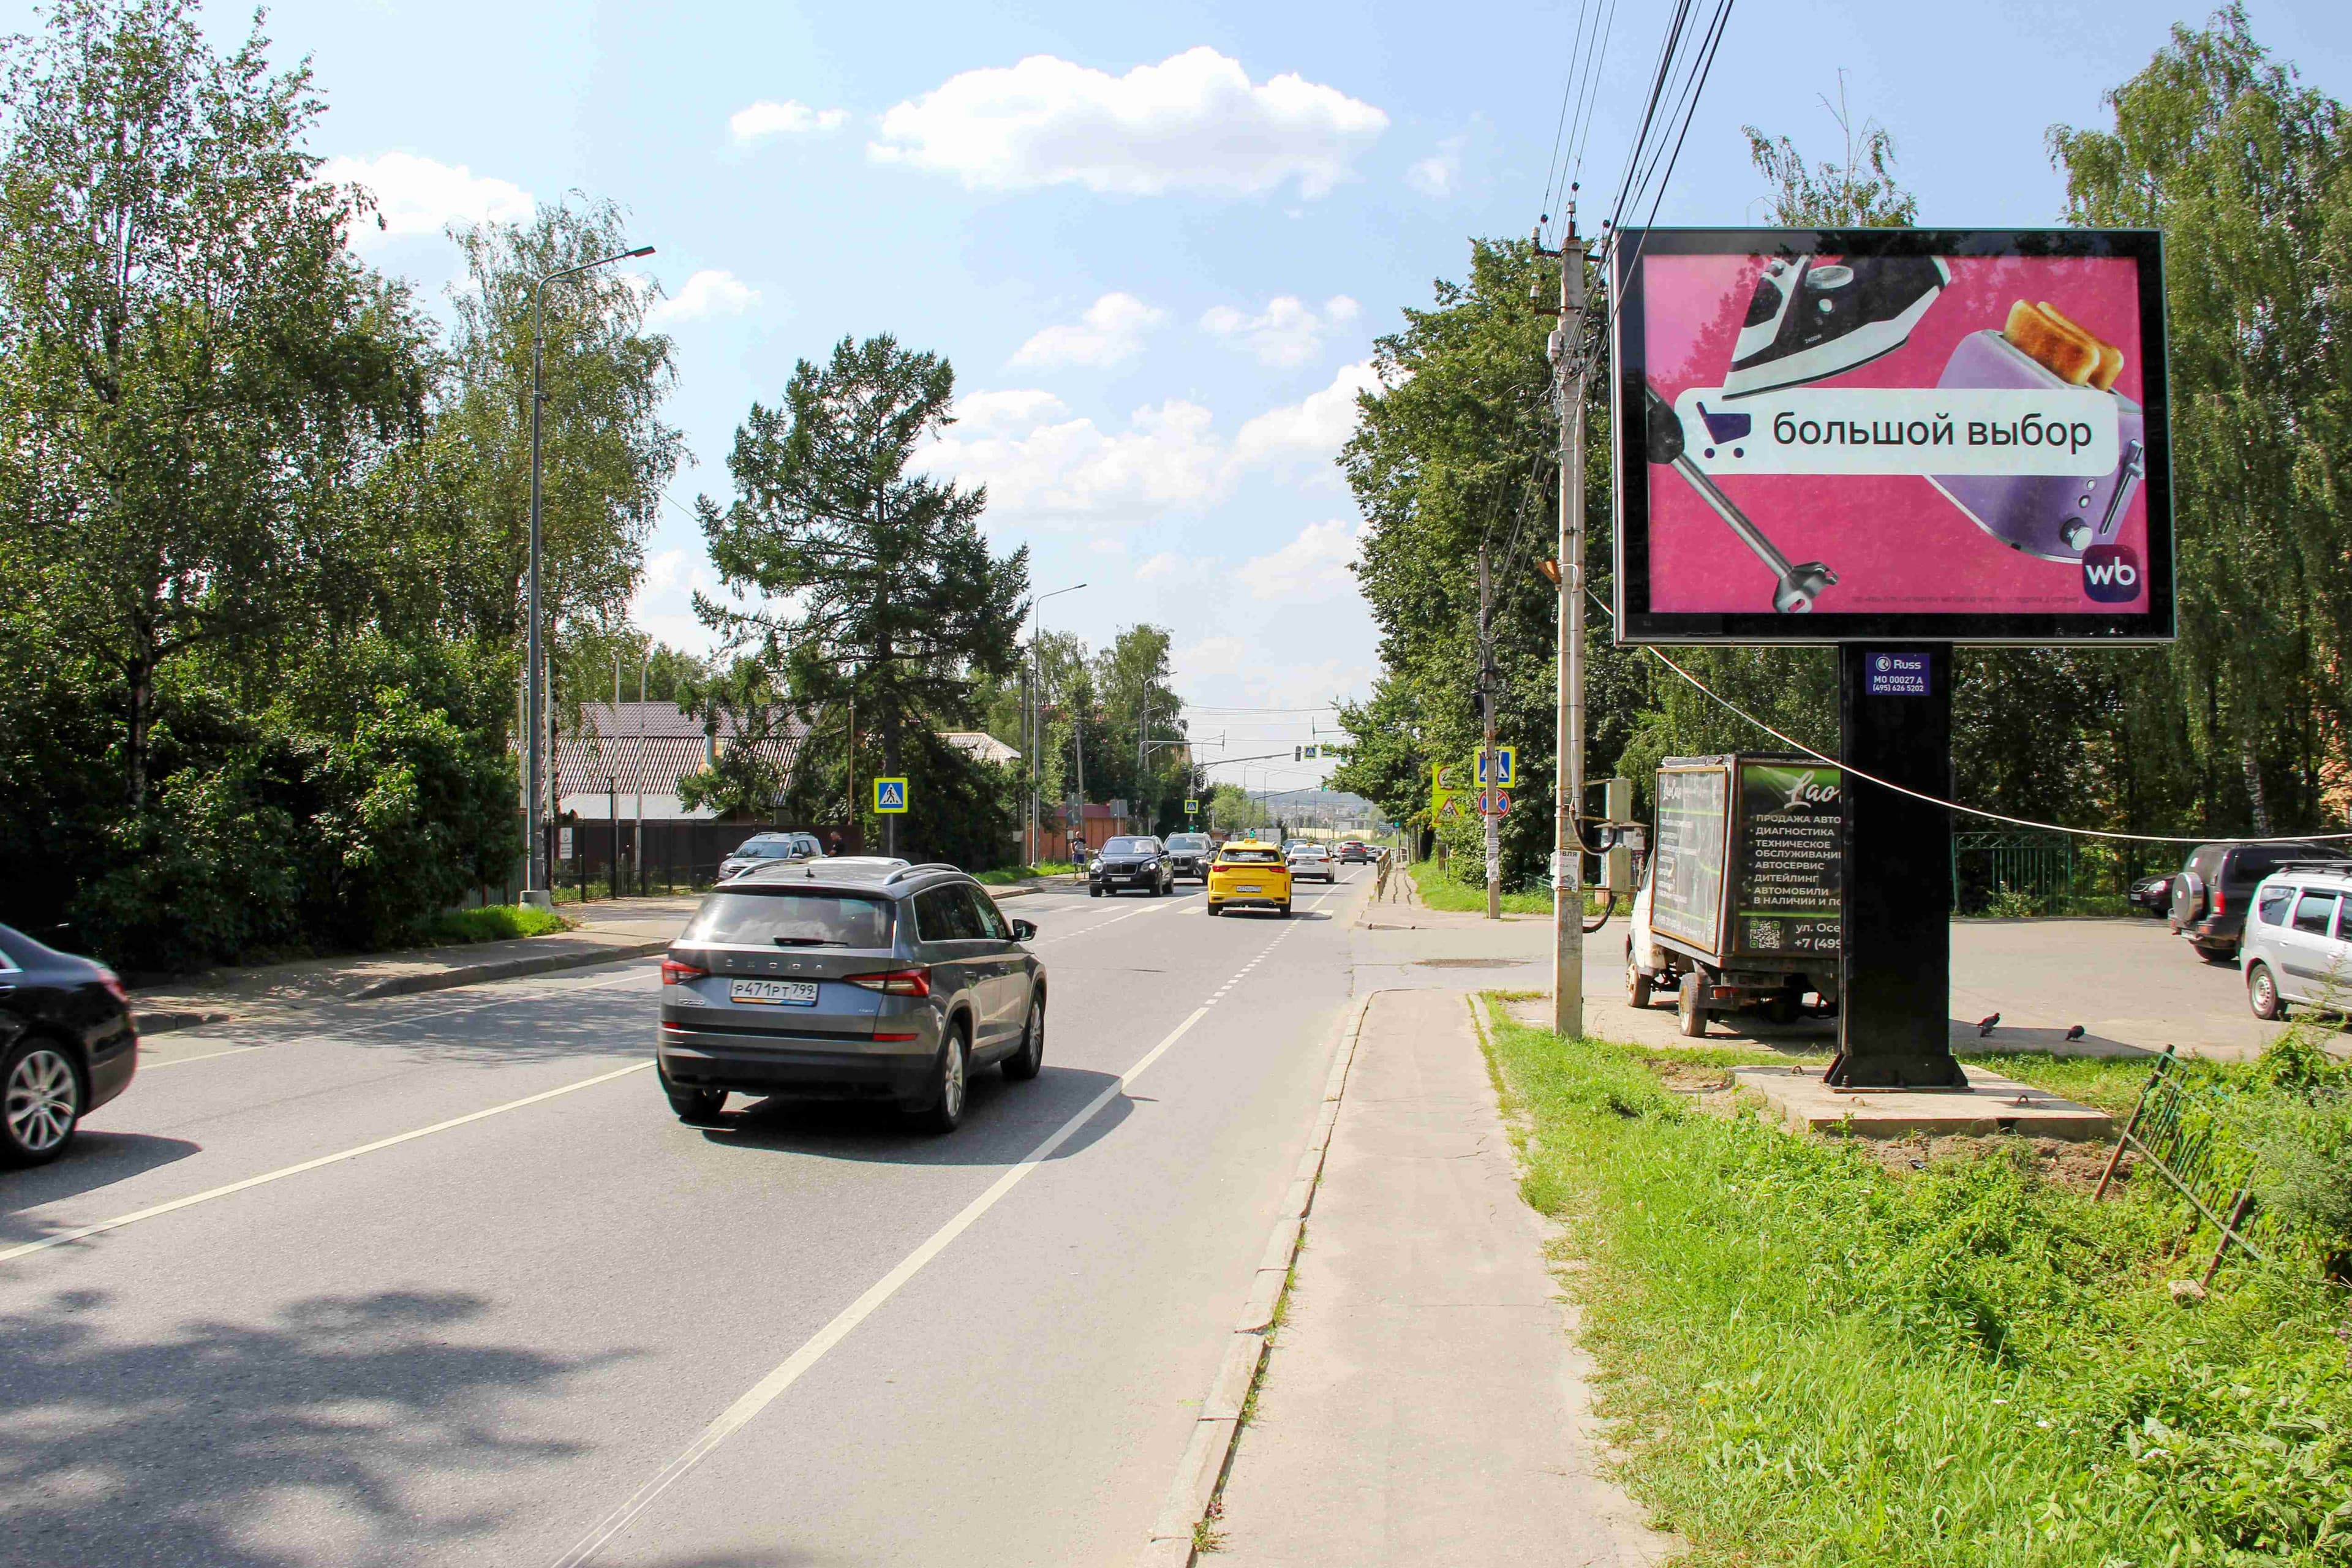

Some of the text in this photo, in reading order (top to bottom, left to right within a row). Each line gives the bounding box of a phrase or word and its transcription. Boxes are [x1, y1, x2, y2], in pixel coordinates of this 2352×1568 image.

[1773, 411, 2092, 455] большой выбор
[2085, 556, 2136, 586] wb
[1893, 659, 1921, 669] Russ
[1889, 676, 1915, 684] 00027
[1784, 770, 1841, 809] Lao
[1756, 814, 1811, 823] ПРОДАЖА
[1755, 827, 1835, 837] ДИАГНОСТИКА
[1755, 839, 1831, 849] ТЕХНИЧЕСКОЕ
[1754, 861, 1825, 870] АВТОСЕРВИС
[1754, 873, 1819, 883] ДИТЕЙЛИНГ
[1754, 887, 1829, 896] АВТОМОБИЛИ
[1795, 924, 1813, 934] ул.
[1794, 938, 1811, 948] +7
[792, 984, 815, 995] 799
